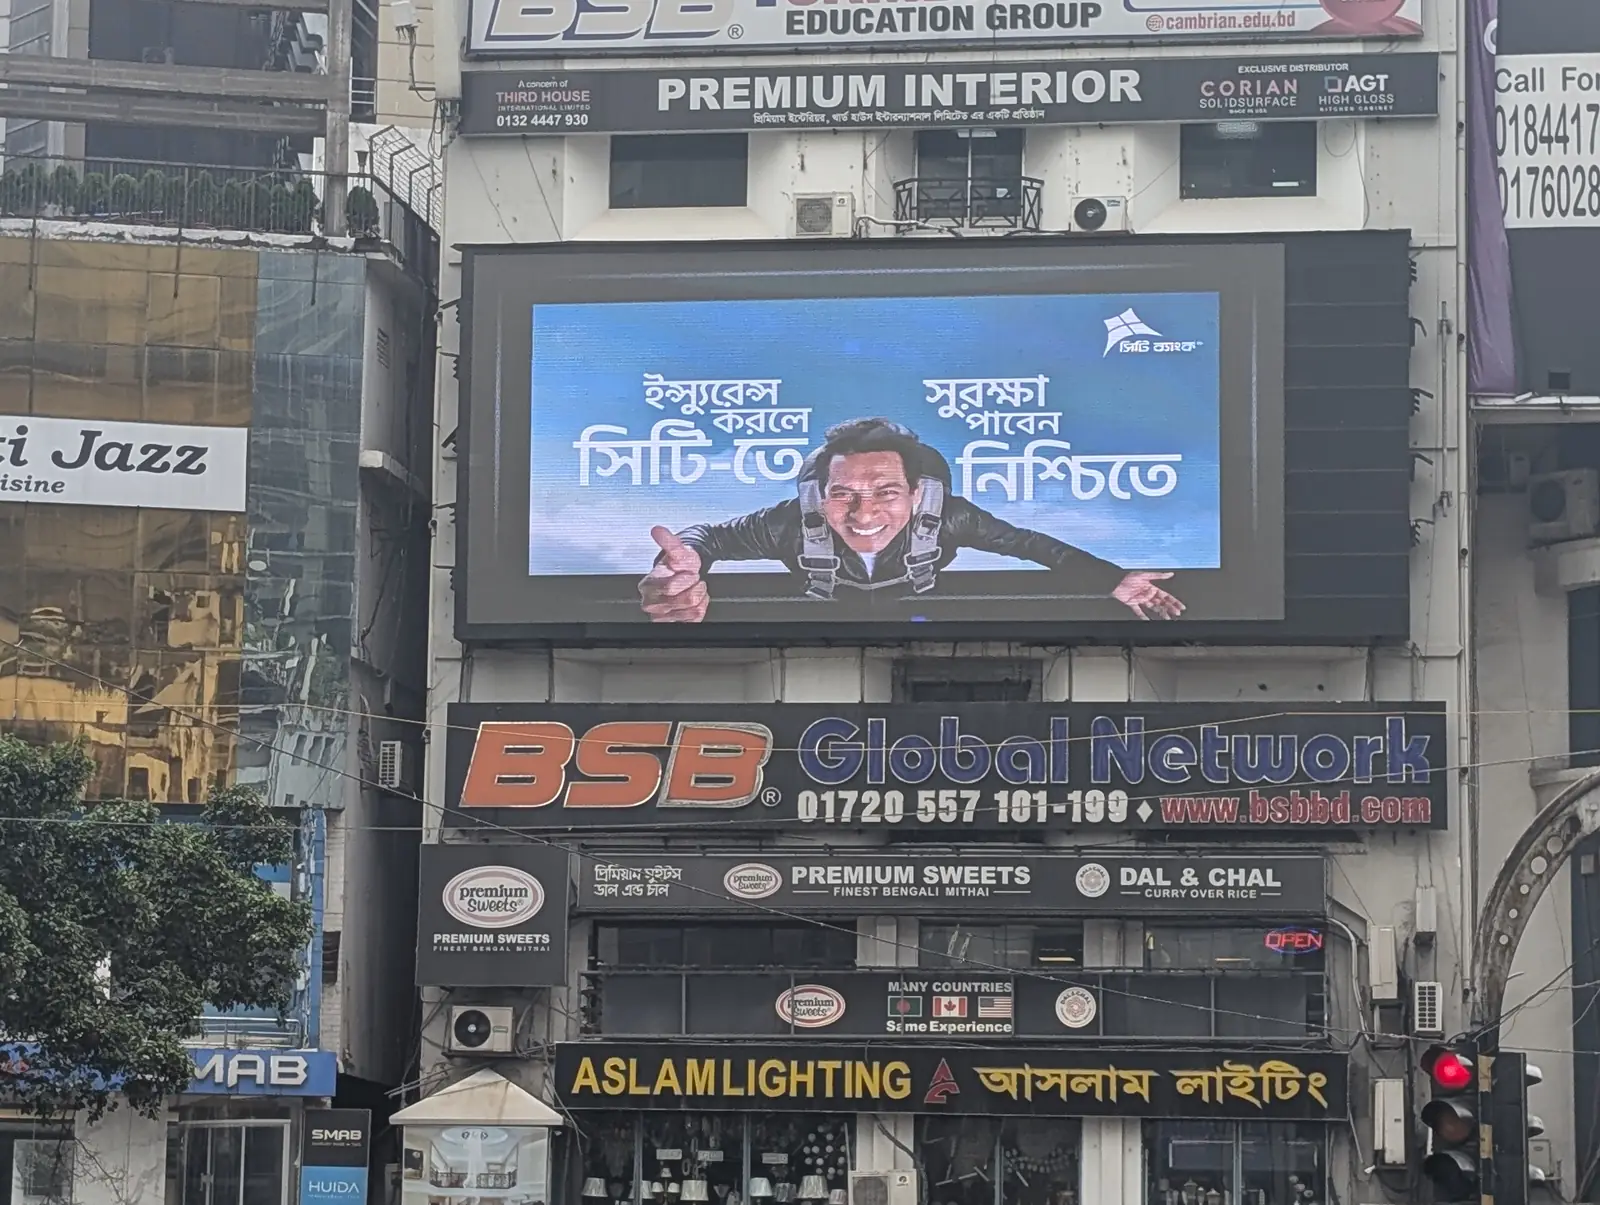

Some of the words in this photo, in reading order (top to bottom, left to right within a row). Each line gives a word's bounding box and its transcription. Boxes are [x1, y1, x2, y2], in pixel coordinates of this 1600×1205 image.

[786, 5, 974, 35] EDUCATION
[986, 2, 1102, 31] GROUP
[1166, 11, 1296, 30] cambrian.edu.bd
[1238, 65, 1287, 73] EXCLUSIVE
[1290, 63, 1349, 72] DISTRIBUTOR
[518, 80, 525, 88] A
[560, 80, 568, 88] of
[1200, 78, 1298, 97] CORIAN
[1344, 75, 1389, 92] AGT
[1495, 67, 1544, 93] Call
[496, 91, 538, 102] THIRD
[541, 90, 590, 102] HOUSE
[658, 74, 885, 111] PREMIUM
[904, 69, 1142, 107] INTERIOR
[1200, 96, 1297, 109] SOLIDSURFACE
[1319, 94, 1349, 105] HIGH
[1354, 94, 1394, 104] GLOSS
[497, 114, 528, 127] 0132
[531, 114, 561, 126] 4447
[565, 113, 589, 125] 930
[1120, 340, 1150, 353] সিটি
[922, 374, 1050, 419] সুরক্ষা
[710, 408, 812, 435] করলে
[965, 410, 1062, 435] পাবেন
[51, 430, 209, 475] Jazz
[955, 439, 1182, 501] নিশ্চিতে
[797, 716, 1070, 785] Global
[1090, 716, 1432, 784] Network
[459, 721, 774, 808] BSB
[798, 790, 904, 823] 01720
[917, 790, 981, 823] 557
[994, 789, 1128, 823] 101-199
[1159, 790, 1431, 824] www.bsbbd.com
[734, 874, 773, 883] premium
[792, 866, 914, 885] PREMIUM
[923, 866, 1031, 885] SWEETS
[1120, 867, 1171, 886] DAL
[1179, 867, 1200, 886] &
[1208, 867, 1281, 887] CHAL
[460, 884, 528, 900] premium
[594, 884, 619, 897] ডাল
[621, 884, 644, 896] এন্ড
[646, 884, 670, 897] চাল
[833, 887, 878, 896] FINEST
[882, 887, 939, 896] BENGALI
[945, 887, 989, 896] MITHAI
[1144, 889, 1186, 898] CURRY
[1190, 889, 1224, 899] OVER
[1228, 889, 1257, 899] RICE
[433, 934, 494, 944] PREMIUM
[498, 933, 550, 944] SWEETS
[1265, 932, 1322, 949] OPEN
[888, 981, 928, 993] MANY
[932, 981, 1012, 993] COUNTRIES
[929, 1020, 1012, 1034] Experience
[193, 1054, 308, 1088] MAB
[572, 1057, 716, 1096] ASLAM
[723, 1059, 911, 1099] LIGHTING
[972, 1063, 1161, 1103] আসলাম
[1169, 1060, 1328, 1110] লাইটিং
[311, 1129, 362, 1140] SMAB
[308, 1181, 360, 1193] HUIDA
